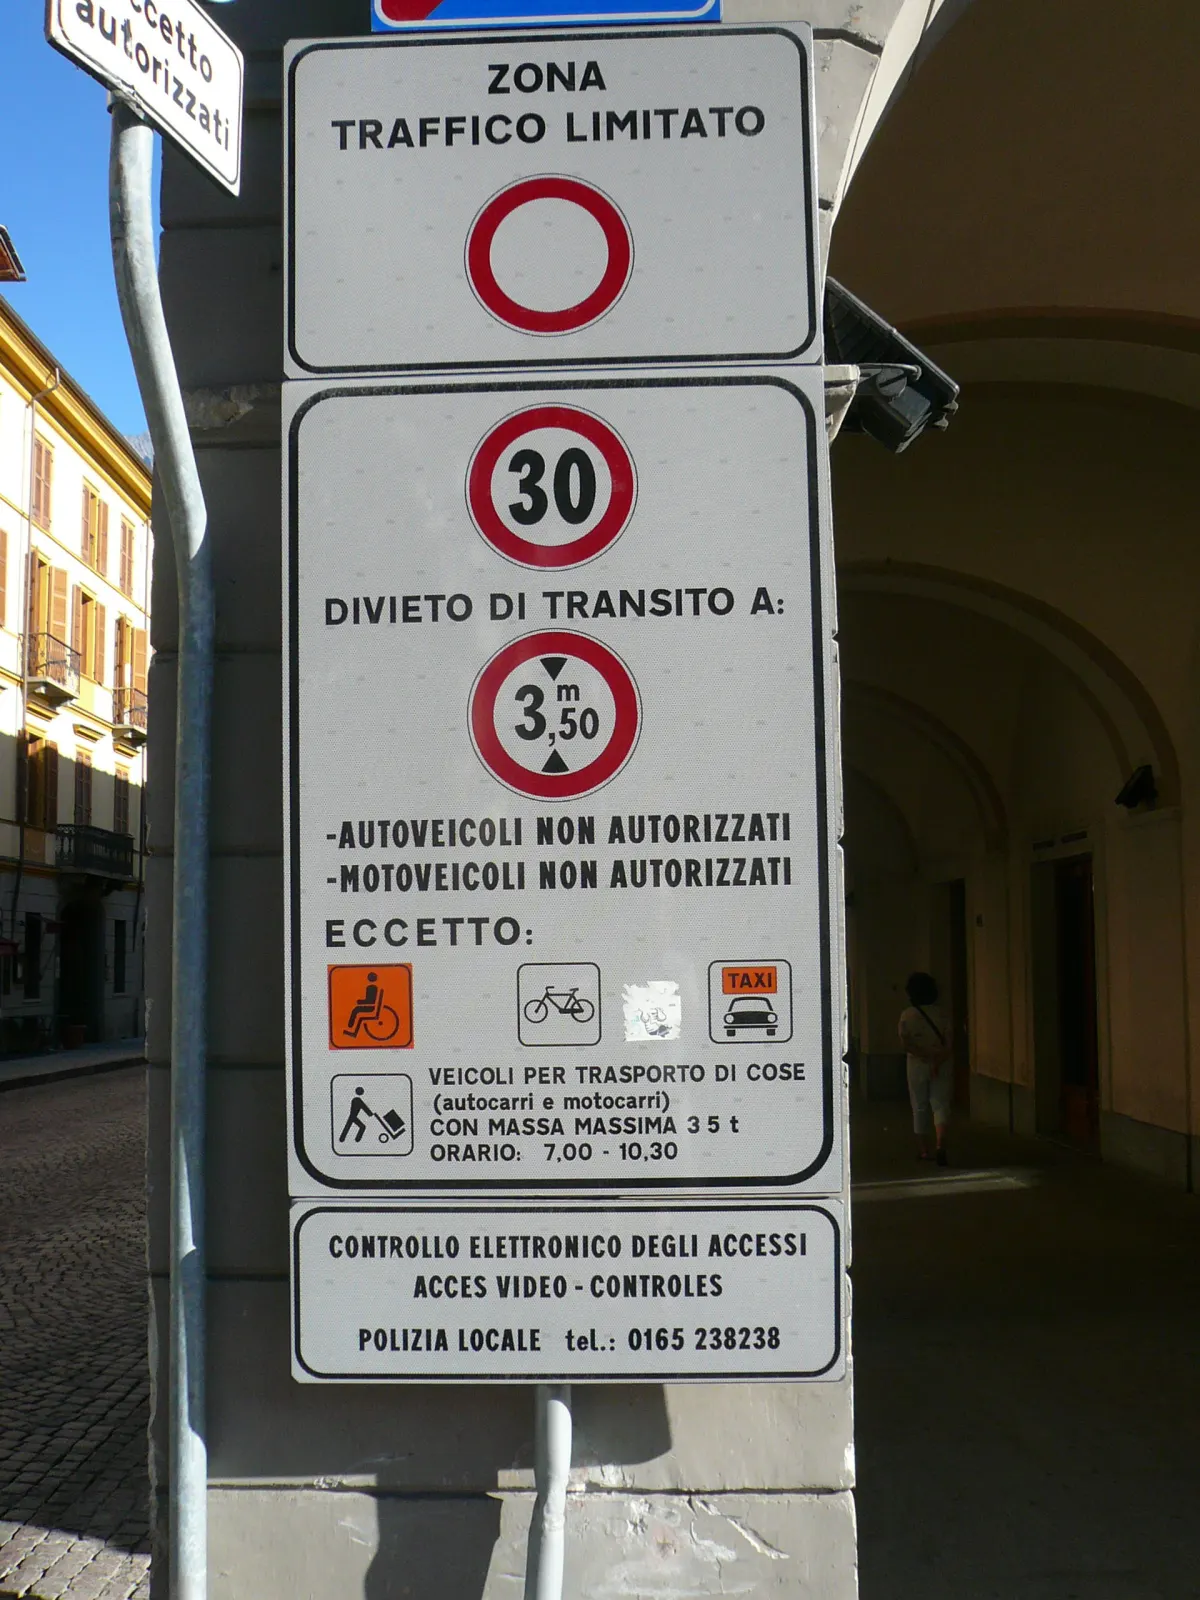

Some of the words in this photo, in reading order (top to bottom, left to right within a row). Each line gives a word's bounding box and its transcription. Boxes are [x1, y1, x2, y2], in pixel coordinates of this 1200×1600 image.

[76, 0, 229, 152] autorizzati
[488, 61, 606, 94] ZONA
[332, 113, 545, 150] TRAFFICO
[567, 106, 765, 142] LIMITATO
[508, 448, 596, 525] 30
[325, 594, 472, 625] DIVIETO
[490, 593, 525, 620] DI
[543, 588, 734, 619] TRANSITO
[750, 587, 783, 614] A:
[537, 816, 594, 845] NON
[608, 813, 790, 844] AUTORIZZATI
[540, 861, 597, 889] NON
[610, 857, 791, 888] AUTORIZZATI
[326, 917, 532, 947] ECCETTO:
[727, 970, 773, 989] TAXI
[429, 1067, 513, 1085] VEICOLI
[525, 1067, 565, 1084] PER
[575, 1065, 705, 1083] TRASPORTO
[715, 1064, 735, 1081] DI
[747, 1063, 805, 1081] COSE
[434, 1093, 533, 1115] (autocarri
[543, 1097, 554, 1110] e
[564, 1091, 669, 1113] motocarri)
[430, 1119, 477, 1136] CON
[489, 1118, 564, 1135] MASSA
[575, 1117, 676, 1135] MASSIMA
[730, 1116, 738, 1133] t
[431, 1144, 520, 1161] ORARIO:
[544, 1143, 592, 1162] 7,00
[620, 1142, 677, 1161] 10,30
[329, 1235, 459, 1258] CONTROLLO
[470, 1235, 621, 1258] ELETTRONICO
[632, 1235, 697, 1257] DEGLI
[708, 1233, 806, 1257] ACCESSI
[414, 1275, 486, 1298] ACCES
[496, 1276, 567, 1298] VIDEO
[590, 1274, 722, 1298] CONTROLES
[359, 1329, 448, 1351] POLIZIA
[459, 1329, 540, 1351] LOCALE
[565, 1329, 615, 1351] tel.:
[628, 1328, 684, 1351] 0165
[695, 1327, 780, 1350] 238238
